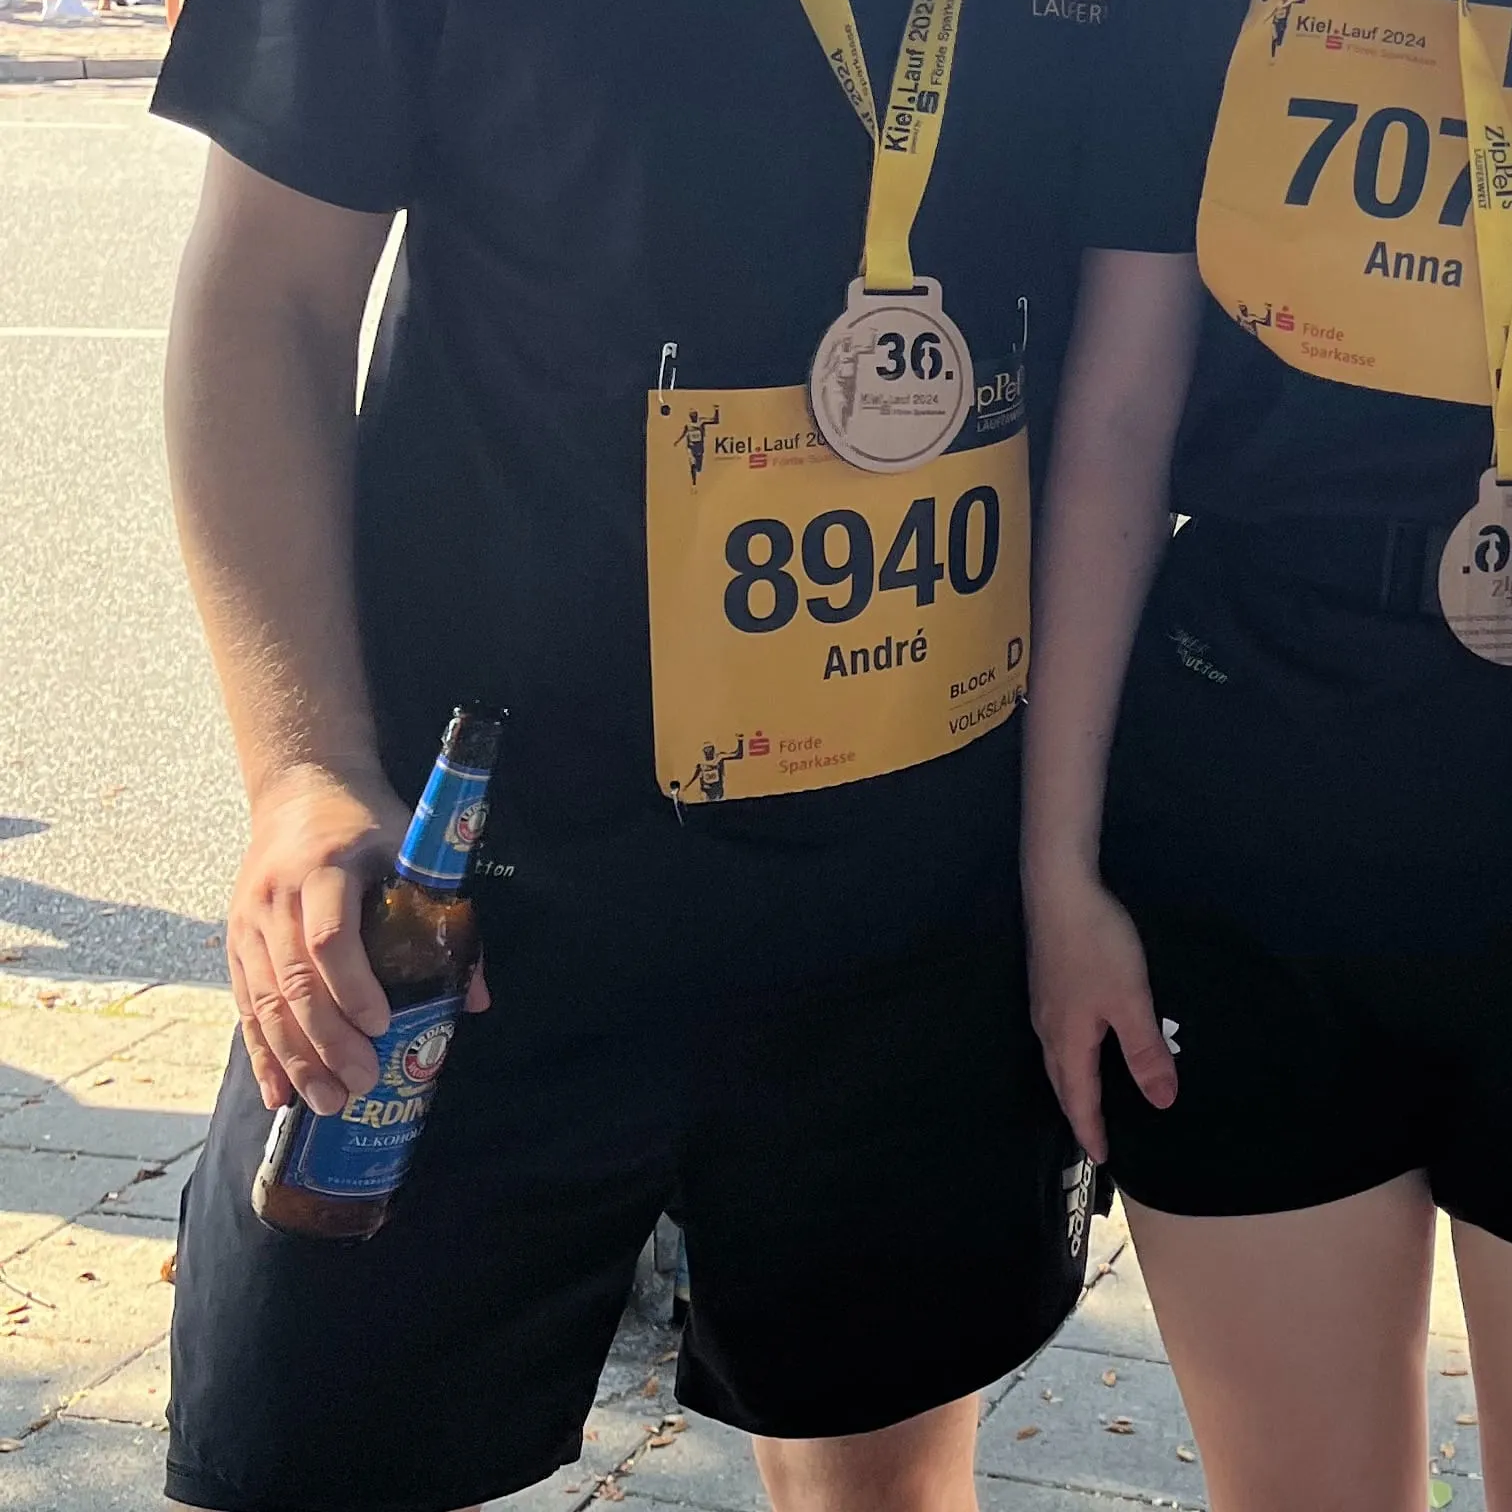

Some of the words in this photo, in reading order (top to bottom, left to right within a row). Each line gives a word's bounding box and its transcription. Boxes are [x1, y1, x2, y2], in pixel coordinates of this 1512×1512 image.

[1382, 28, 1427, 49] 2024
[830, 47, 864, 107] 2024
[931, 46, 948, 87] Förde
[1364, 240, 1464, 289] Anna
[1302, 323, 1345, 342] Förde
[1301, 342, 1376, 367] Sparkasse
[912, 393, 939, 406] 2024
[805, 431, 828, 448] 20
[723, 486, 1001, 635] 8940
[823, 628, 928, 681] André
[950, 667, 996, 699] BLOCK
[1007, 635, 1024, 673] D
[778, 737, 824, 754] Förde
[778, 751, 857, 776] Sparkasse
